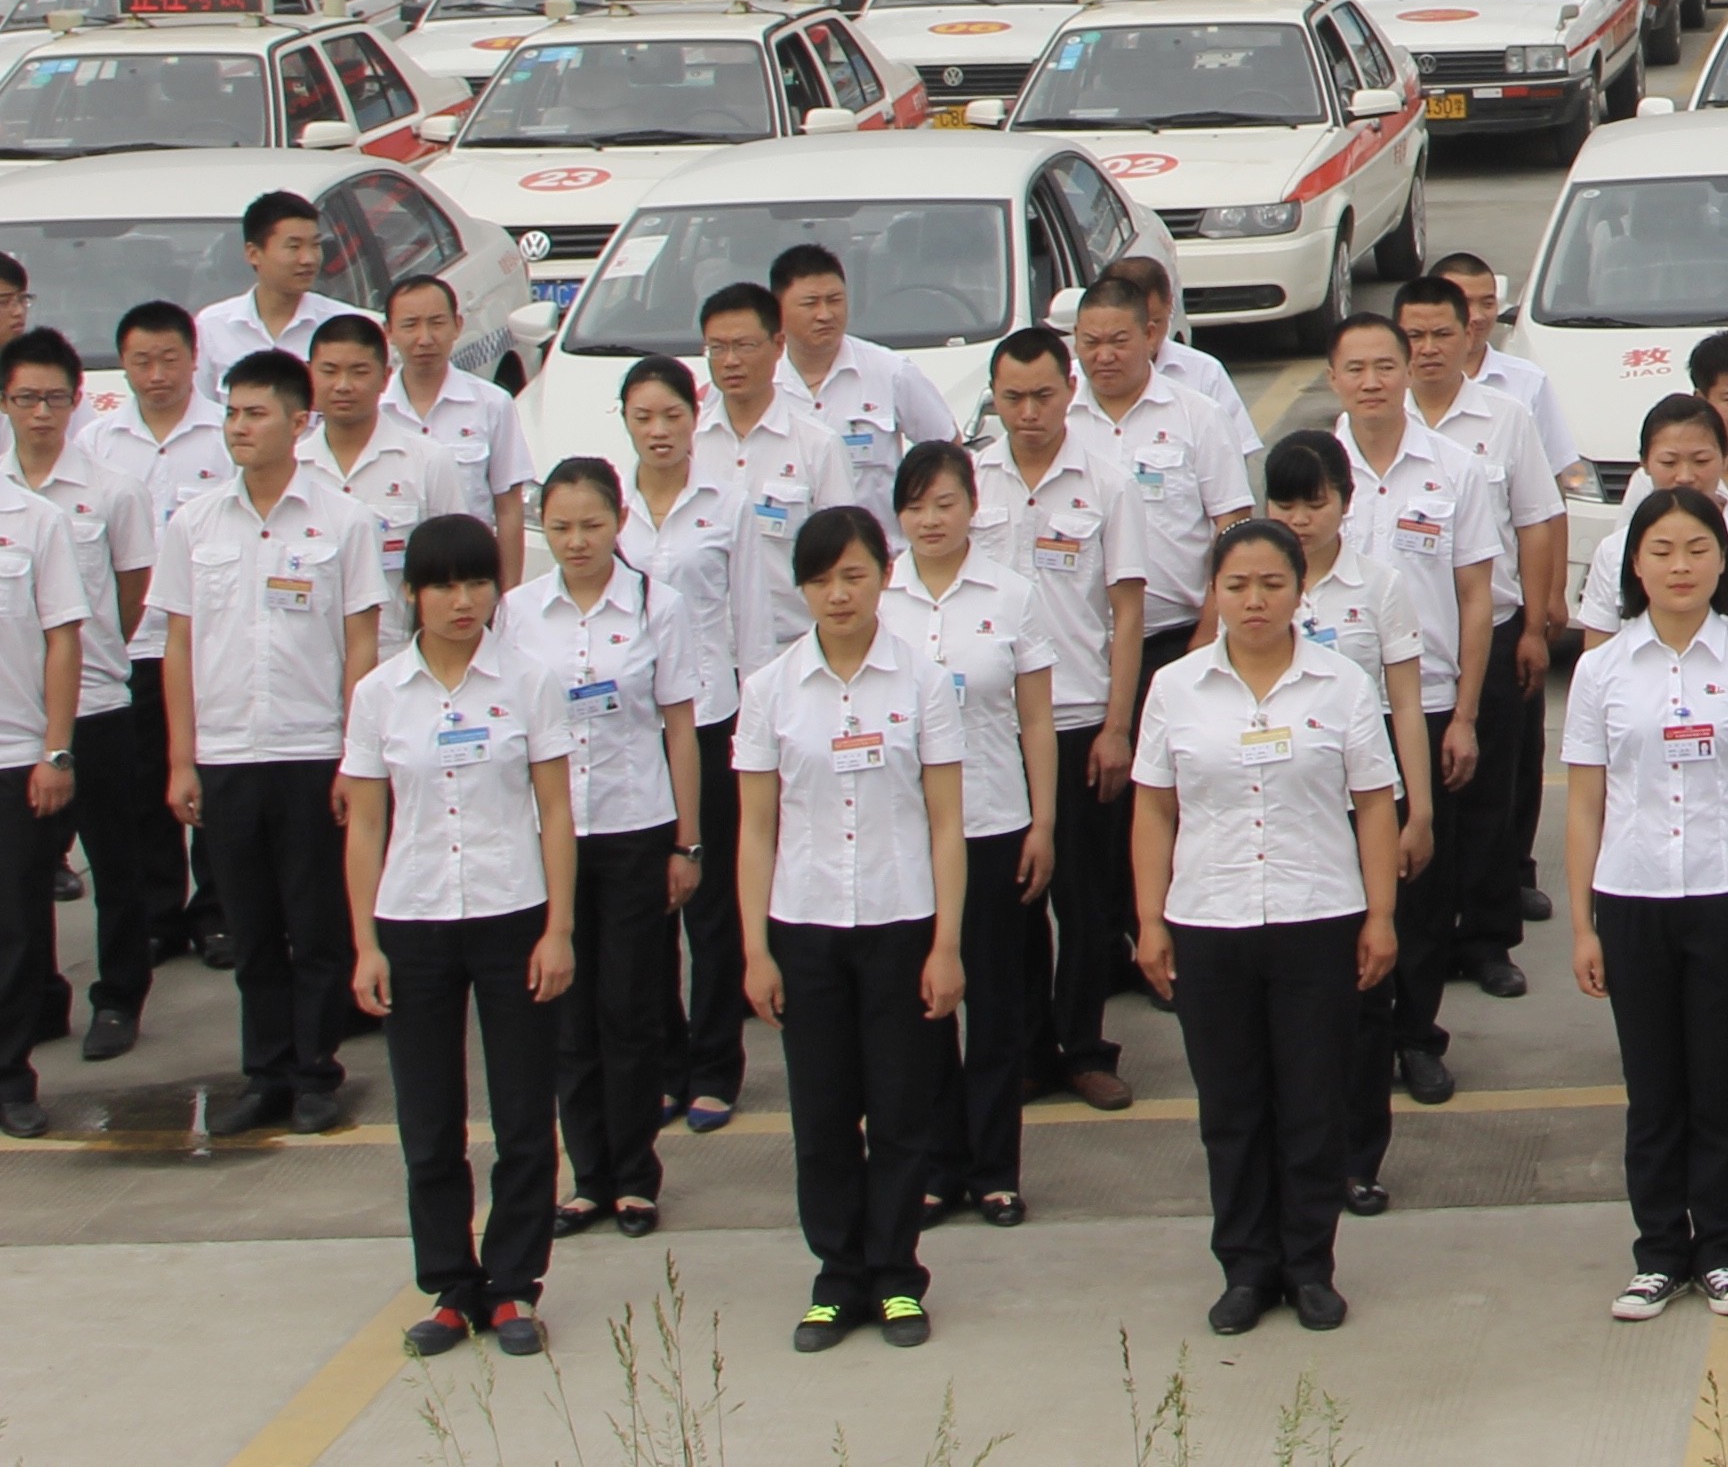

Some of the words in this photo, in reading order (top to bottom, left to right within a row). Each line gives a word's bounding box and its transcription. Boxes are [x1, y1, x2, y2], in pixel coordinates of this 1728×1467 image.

[1102, 158, 1166, 174] 02
[528, 171, 602, 188] 23
[1621, 347, 1671, 368] 教
[1619, 367, 1672, 379] JIAO
